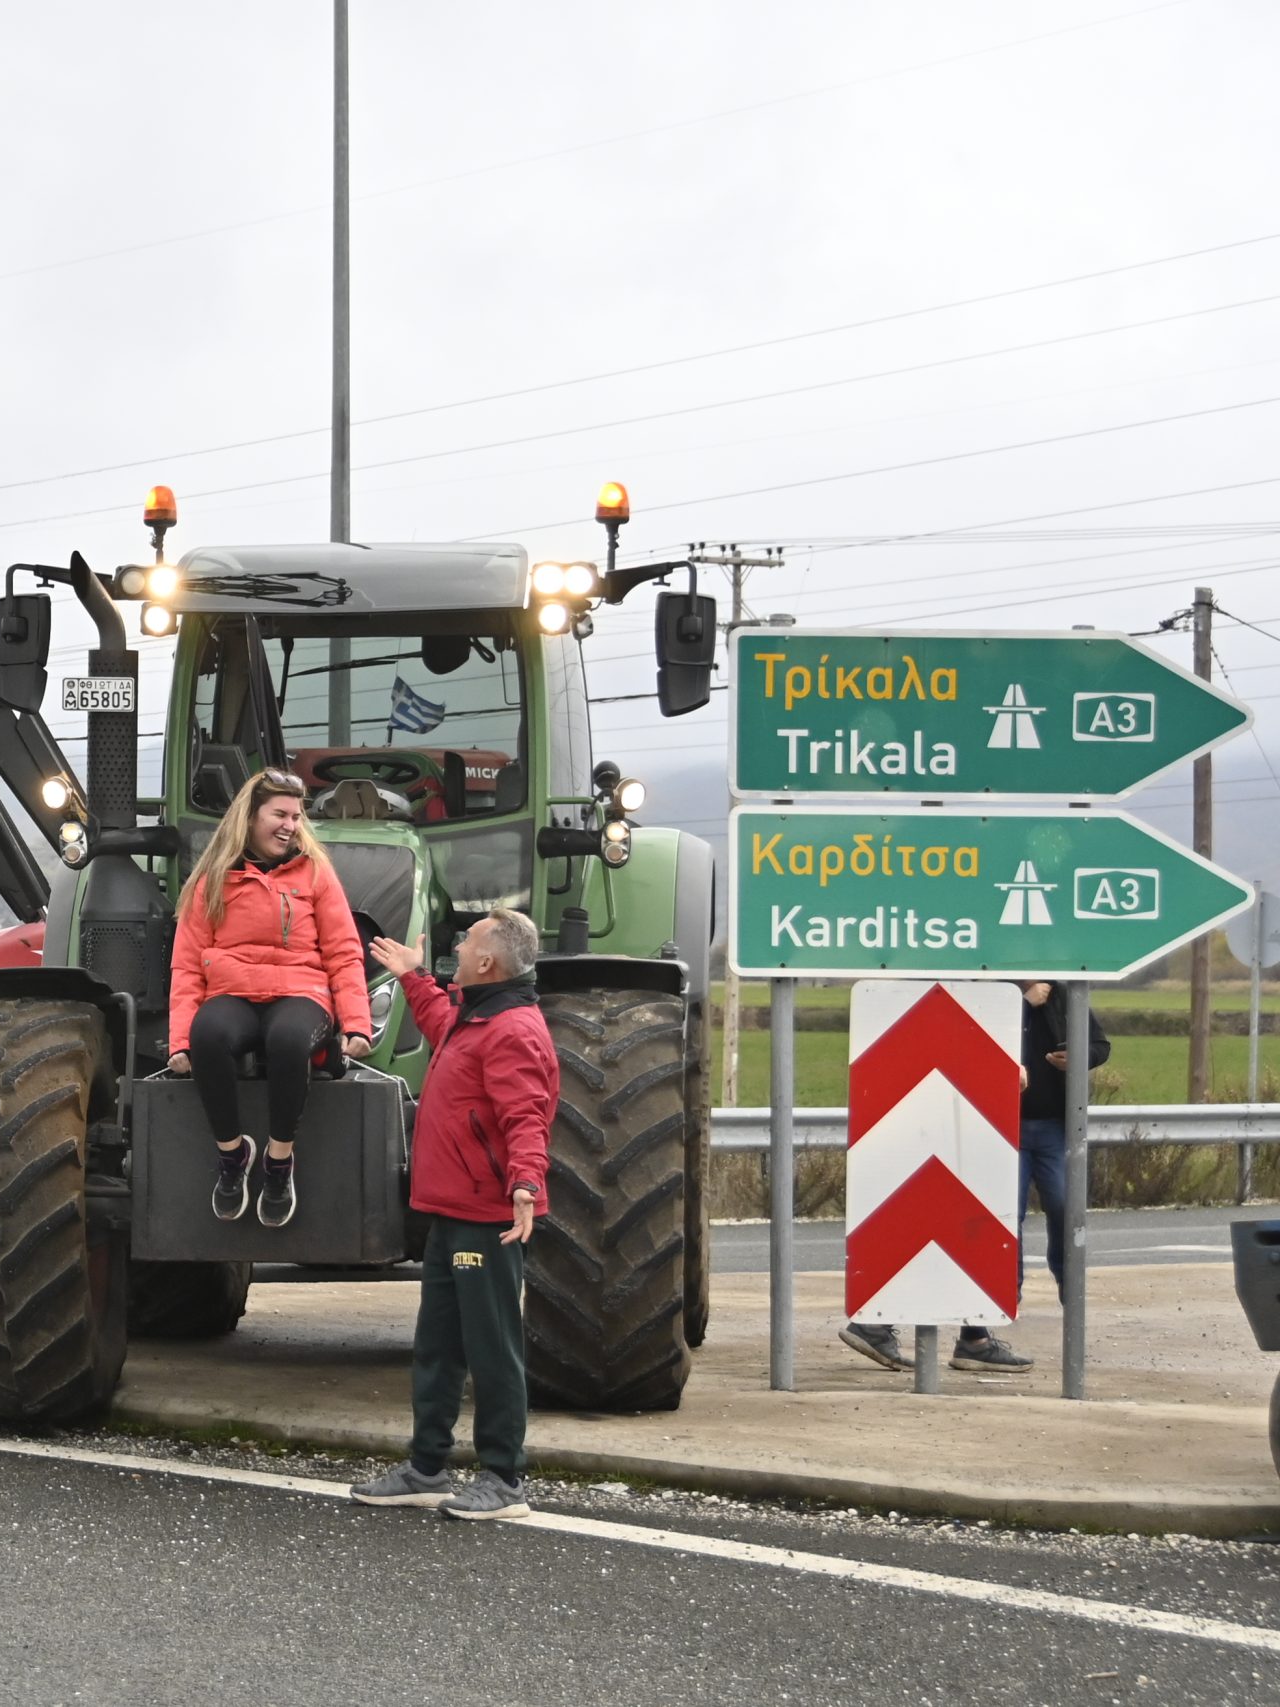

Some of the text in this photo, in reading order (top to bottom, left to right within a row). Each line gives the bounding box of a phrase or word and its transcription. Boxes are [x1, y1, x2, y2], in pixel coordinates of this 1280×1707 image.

[80, 690, 131, 708] 65805
[754, 653, 958, 710] Τρίκαλα
[1089, 702, 1137, 734] A3
[776, 728, 958, 776] Trikala
[752, 832, 979, 886] Καρδίτσα
[1090, 877, 1141, 911] A3
[770, 904, 979, 950] Karditsa
